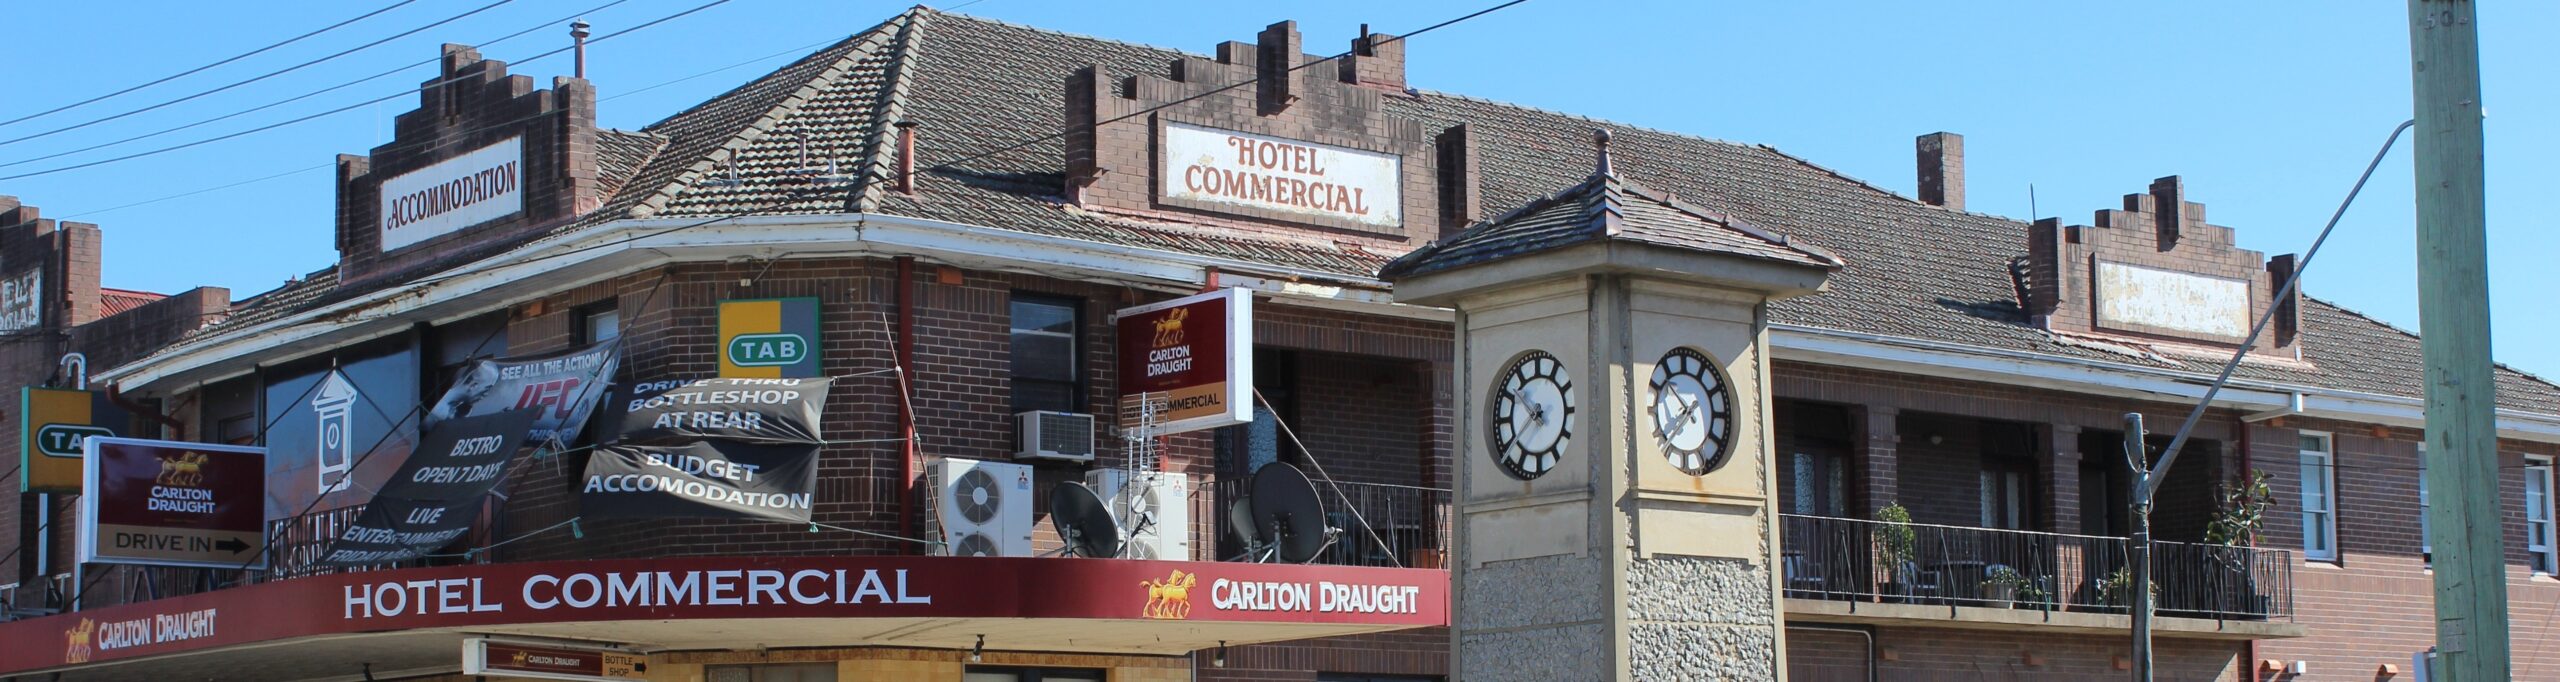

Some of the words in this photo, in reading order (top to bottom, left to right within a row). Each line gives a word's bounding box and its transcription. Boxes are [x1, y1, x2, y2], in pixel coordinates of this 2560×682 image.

[1228, 135, 1325, 176] HOTEL
[387, 160, 517, 230] ACCOMMODATION
[1185, 164, 1369, 216] COMMERCIAL
[741, 341, 798, 359] TAB
[1149, 345, 1190, 363] CARLTON
[501, 366, 522, 380] SEE
[520, 363, 541, 377] ALL
[543, 360, 563, 375] THE
[1147, 358, 1192, 377] DRAUGHT
[633, 379, 708, 394] DRIVE
[514, 377, 580, 420] UFC
[628, 391, 799, 413] BOTTLESHOP
[653, 413, 688, 429] AT
[692, 412, 762, 430] REAR
[51, 432, 84, 450] TA
[450, 435, 503, 457] BISTRO
[413, 467, 454, 483] OPEN
[456, 467, 468, 483] 7
[465, 460, 505, 483] DAYS
[647, 453, 760, 482] BUDGET
[151, 485, 212, 500] CARLTON
[584, 474, 810, 509] ACCOMODATION
[148, 498, 216, 514] DRAUGHT
[405, 508, 447, 525] LIVE
[116, 532, 184, 551] DRIVE
[189, 536, 212, 552] IN
[326, 549, 385, 562] FRIDAY
[344, 577, 502, 619] HOTEL
[522, 568, 932, 611] COMMERCIAL
[1211, 578, 1312, 612] CARLTON
[1319, 581, 1420, 614] DRAUGHT
[98, 618, 151, 650] CARLTON
[155, 608, 216, 643] DRAUGHT
[528, 655, 553, 665] CARLTON
[554, 657, 580, 667] DRAUGHT
[605, 656, 633, 666] BOTTLE
[609, 667, 630, 677] SHOP
